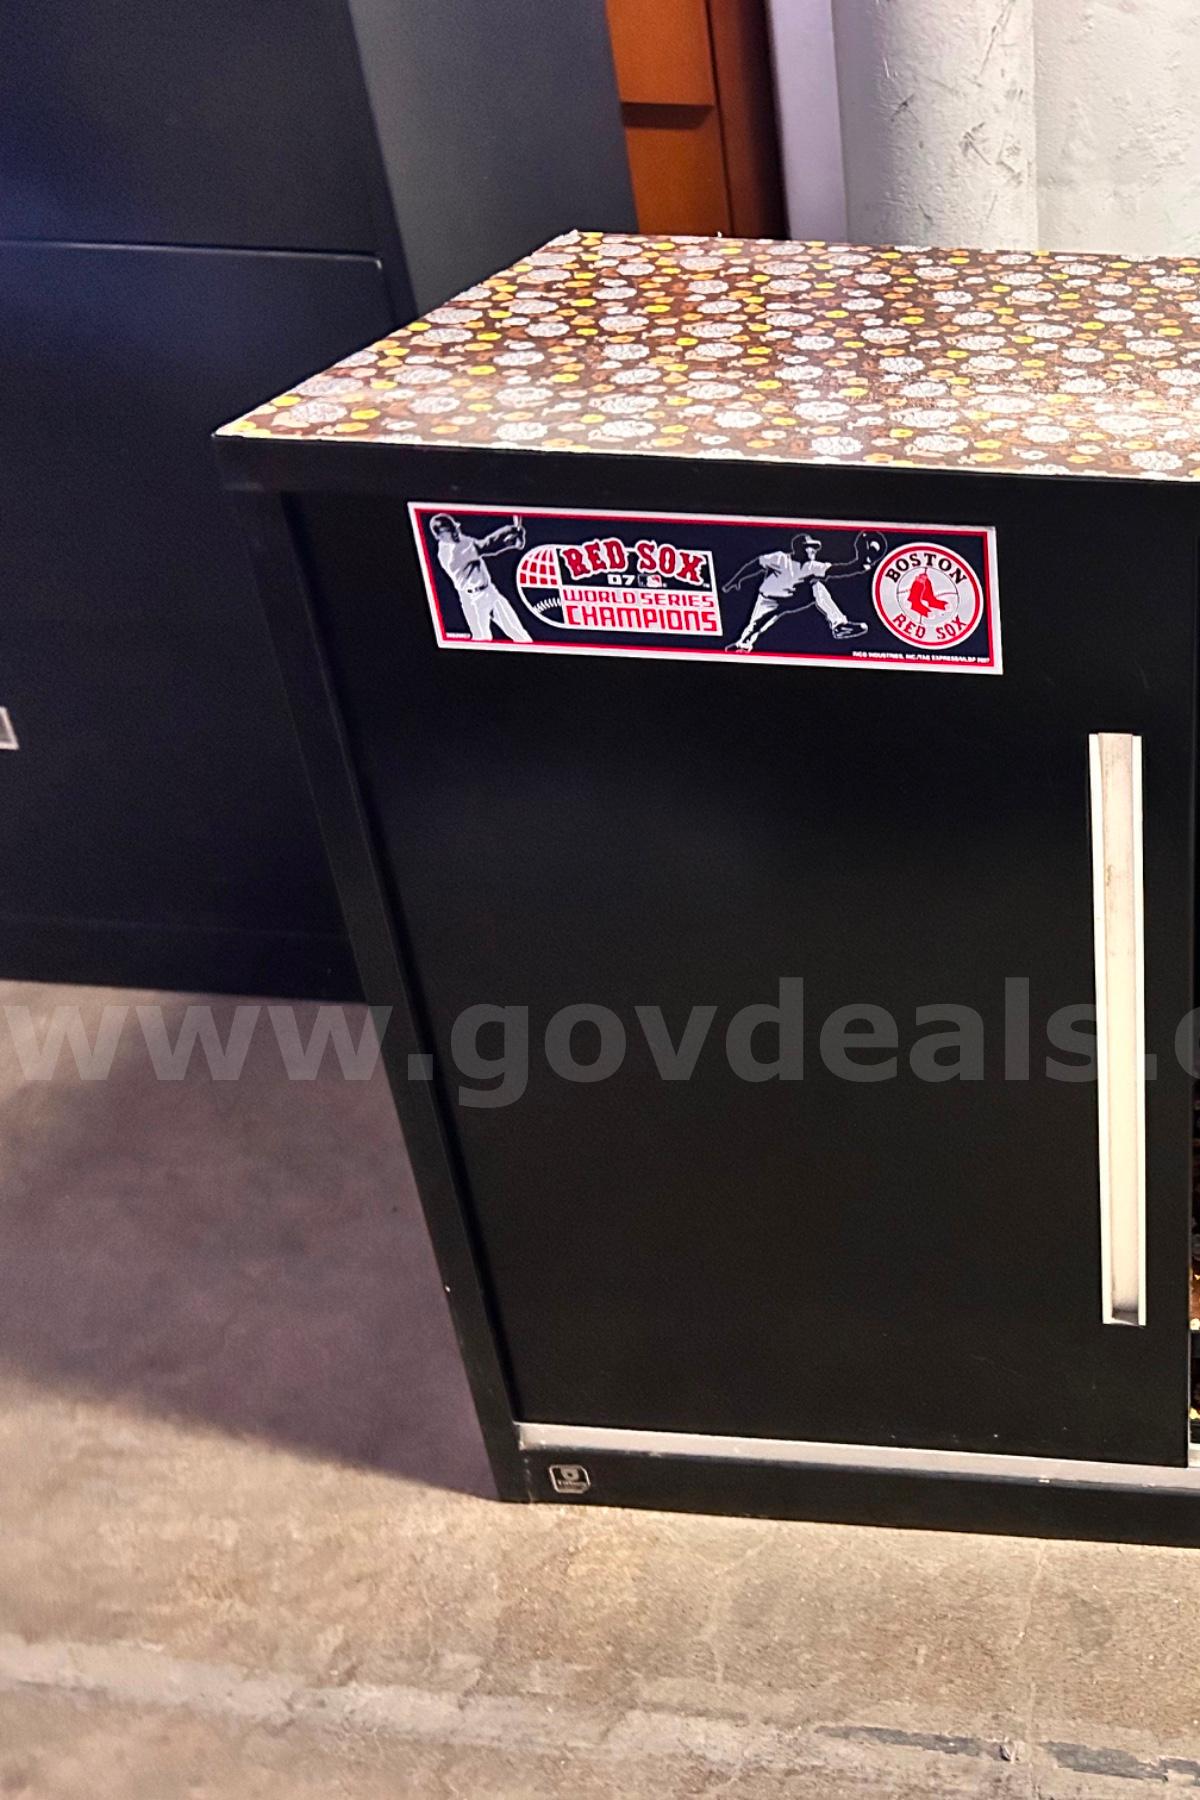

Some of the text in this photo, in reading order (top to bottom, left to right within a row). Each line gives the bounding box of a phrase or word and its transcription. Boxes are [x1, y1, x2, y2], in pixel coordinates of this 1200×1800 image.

[561, 539, 705, 584] RED SOX
[885, 552, 967, 584] BOSTON
[607, 574, 635, 585] 07
[563, 589, 714, 608] WORLD SERIES
[566, 605, 718, 632] CHAMPIONS
[892, 613, 967, 640] RED SOX
